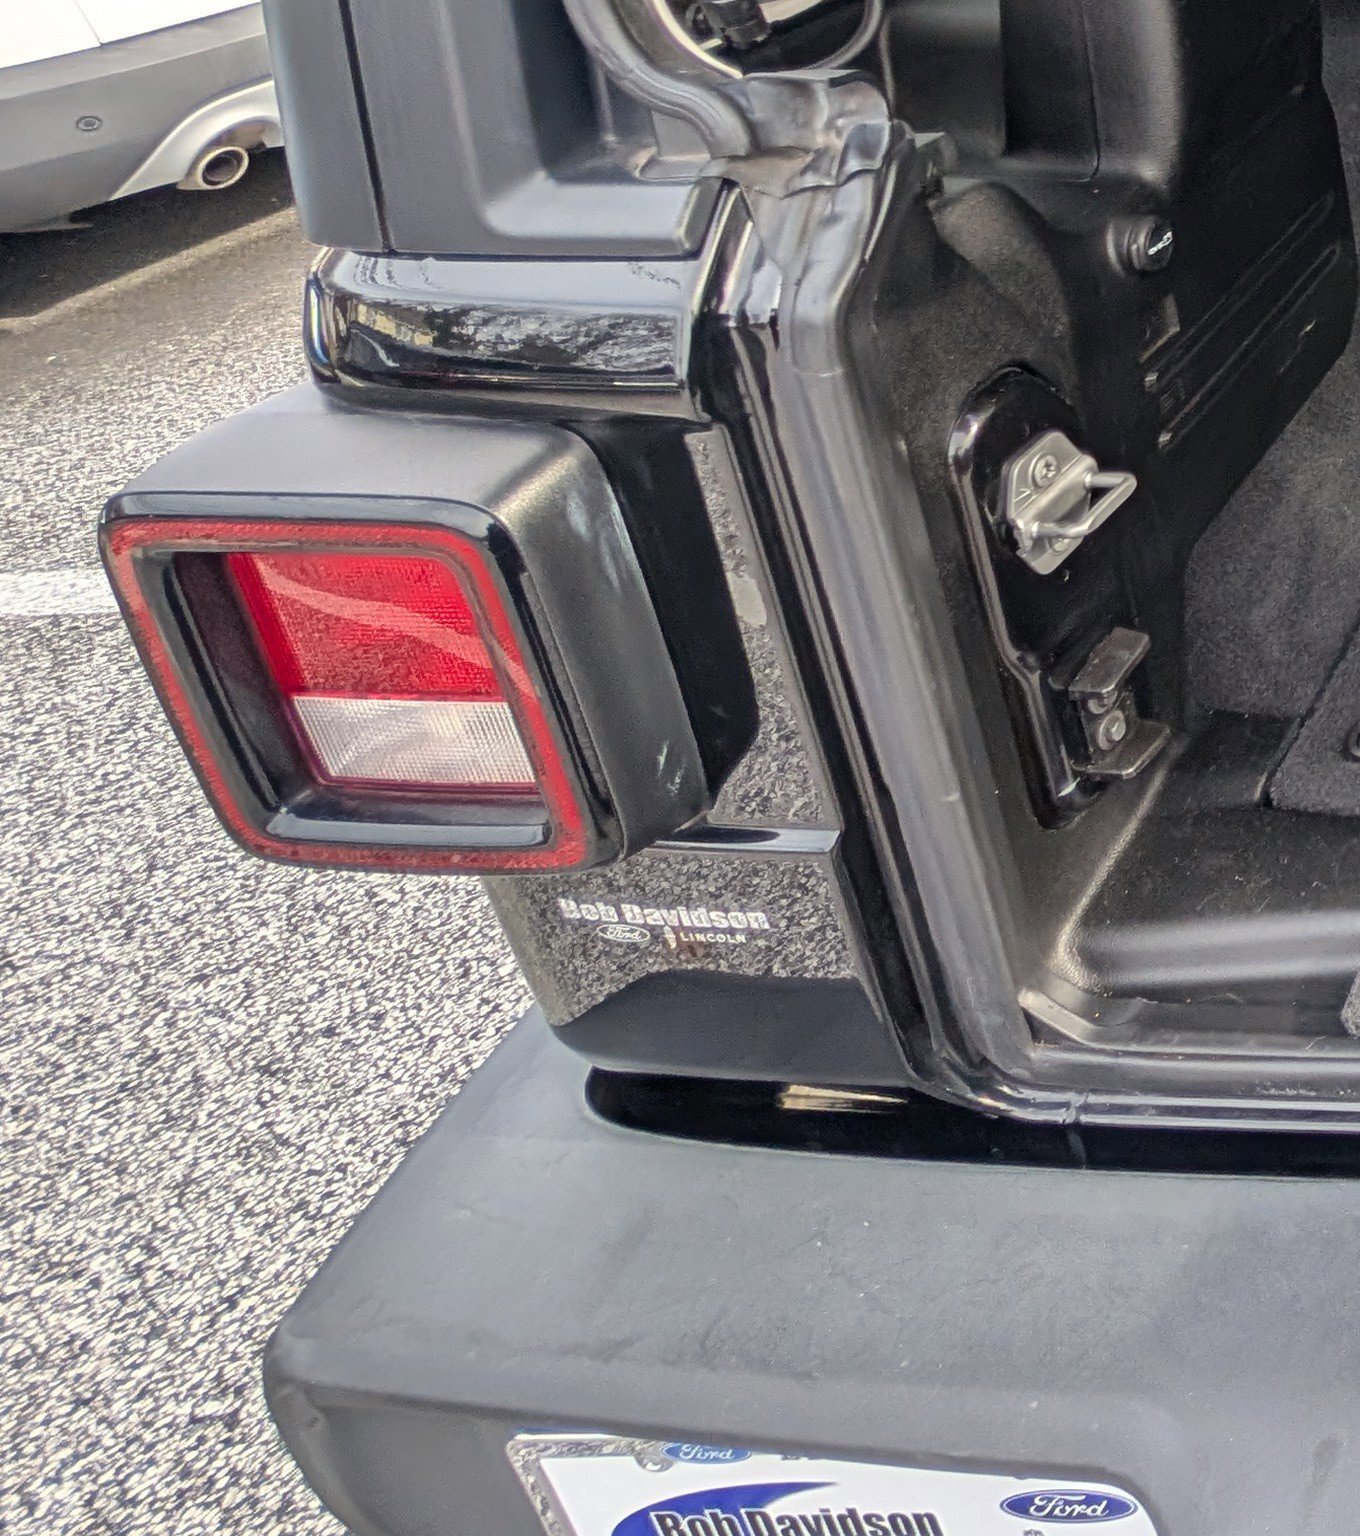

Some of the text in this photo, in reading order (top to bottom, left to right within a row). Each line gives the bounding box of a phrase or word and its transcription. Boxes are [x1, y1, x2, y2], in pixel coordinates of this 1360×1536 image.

[557, 897, 771, 930] Bob Davidson
[680, 932, 747, 944] LINCOLN
[1029, 1494, 1110, 1517] Ford
[745, 1507, 944, 1536] Davidson
